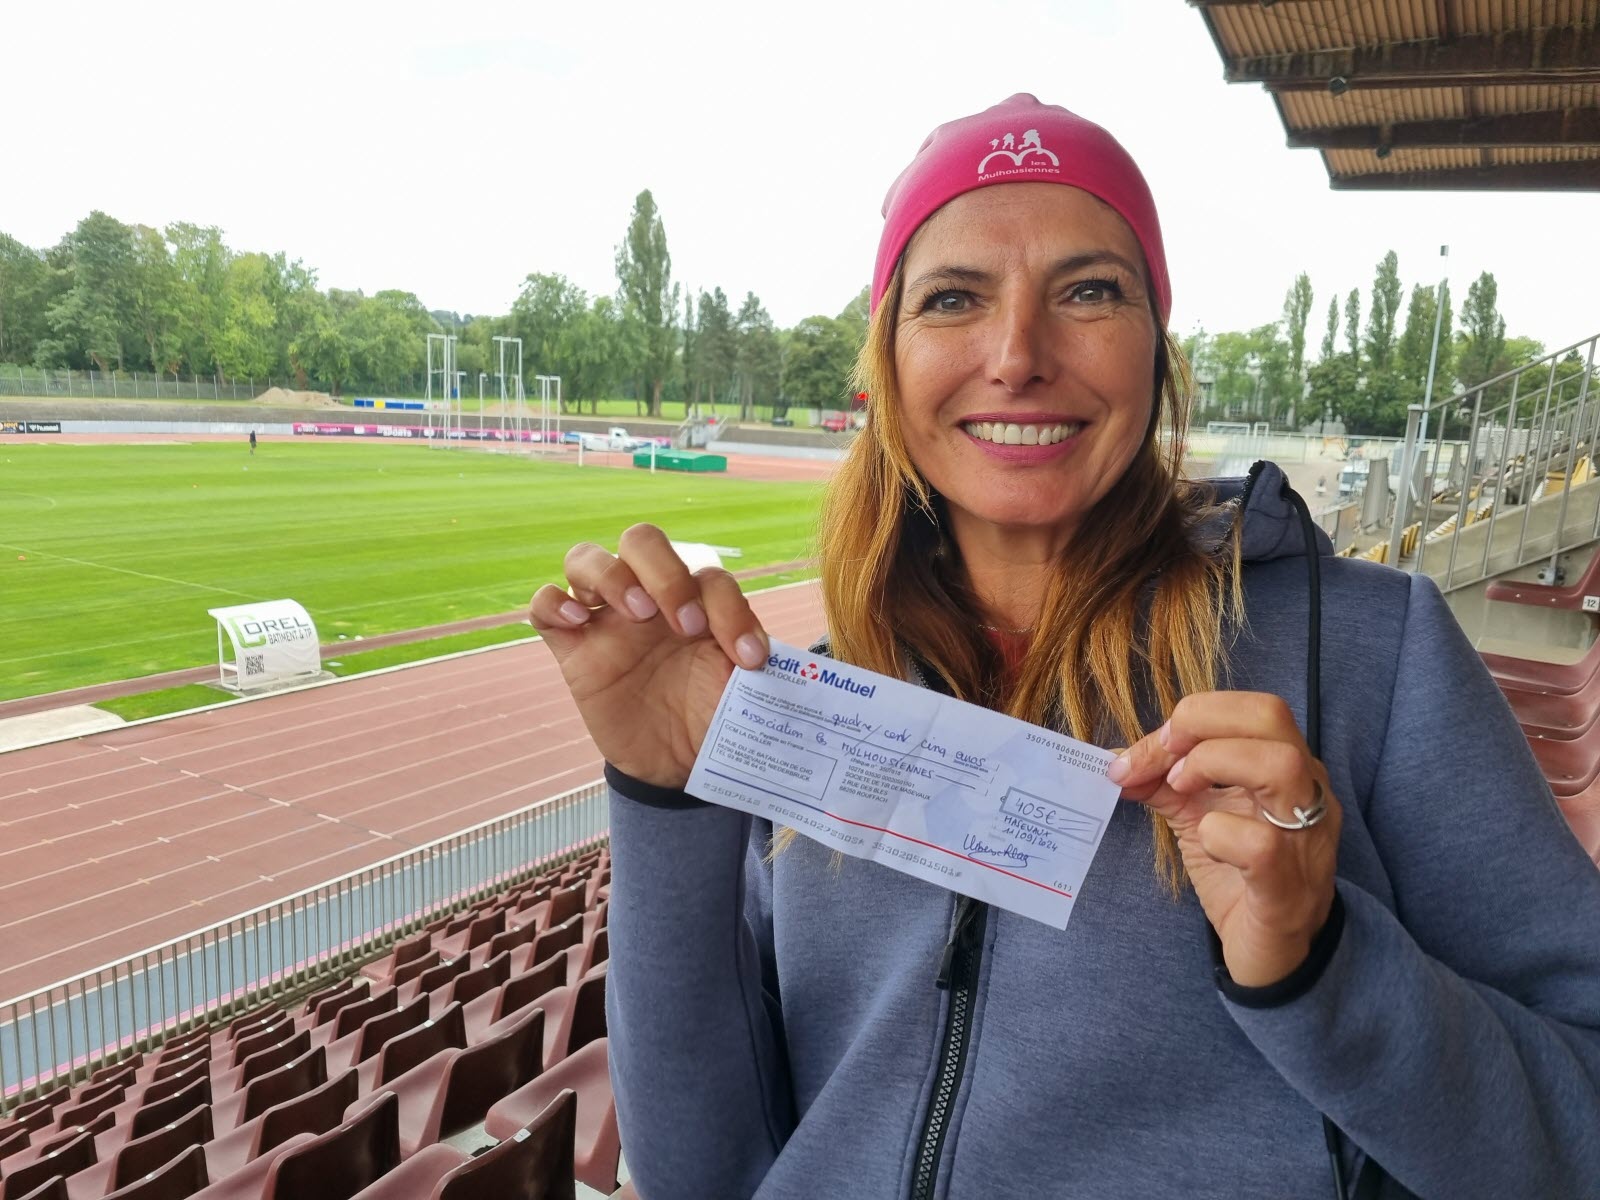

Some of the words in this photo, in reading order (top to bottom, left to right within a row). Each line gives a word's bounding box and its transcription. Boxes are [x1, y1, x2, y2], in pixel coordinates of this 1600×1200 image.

[978, 167, 1060, 182] Mulhousiennes
[1586, 600, 1596, 608] 12
[776, 672, 808, 687] DOLLER
[820, 669, 876, 698] Mutuel
[742, 708, 804, 738] Association
[724, 738, 737, 747] RUE
[747, 732, 772, 747] DOLLER
[920, 738, 948, 758] cinq
[734, 747, 767, 766] MASEVAUX
[899, 786, 931, 800] MASEVAUX
[1016, 798, 1056, 825] 405€
